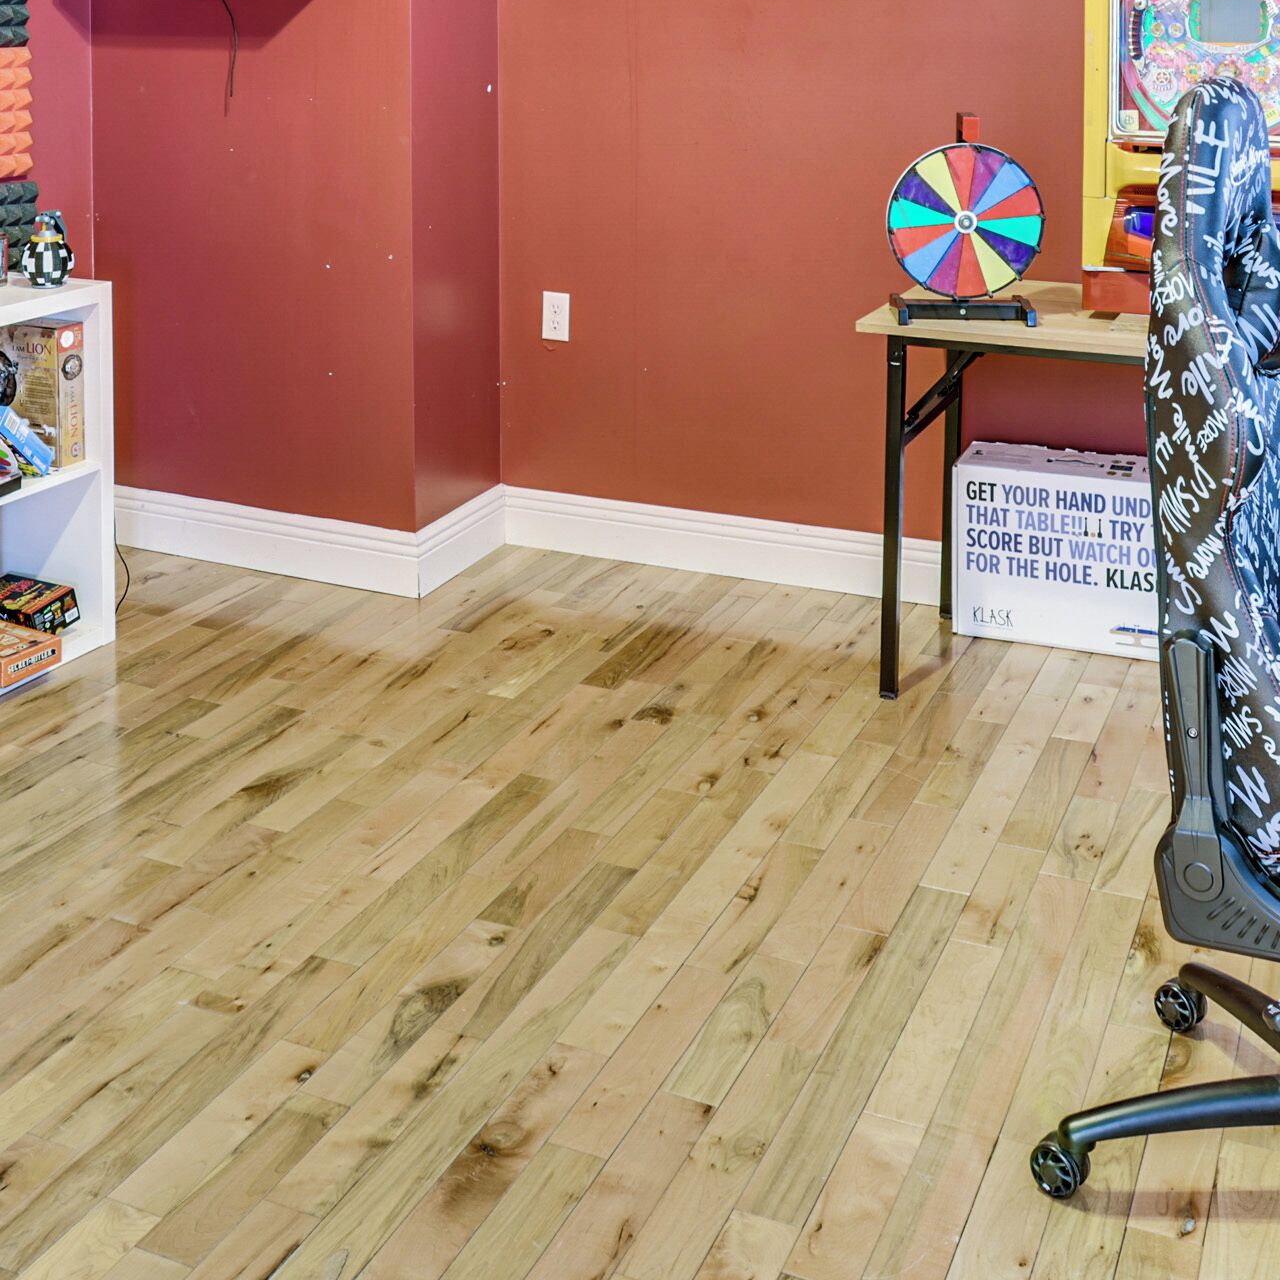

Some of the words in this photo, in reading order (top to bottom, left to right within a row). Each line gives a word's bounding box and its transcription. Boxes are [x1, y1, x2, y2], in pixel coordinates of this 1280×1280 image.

[26, 342, 53, 356] LION
[966, 481, 997, 503] GET
[1001, 484, 1050, 508] YOUR
[1056, 490, 1106, 514] HAND
[966, 504, 1010, 528] THAT
[1015, 510, 1084, 536] TABLE!!
[1109, 519, 1145, 543] TRY
[966, 528, 1023, 554] SCORE
[1029, 535, 1063, 558] BUT
[1069, 539, 1131, 566] WATCH
[966, 551, 1001, 575] FOR
[1006, 556, 1040, 579] THE
[1045, 561, 1098, 586] HOLE.
[1106, 568, 1157, 593] KLAS
[973, 606, 1015, 628] KLASK
